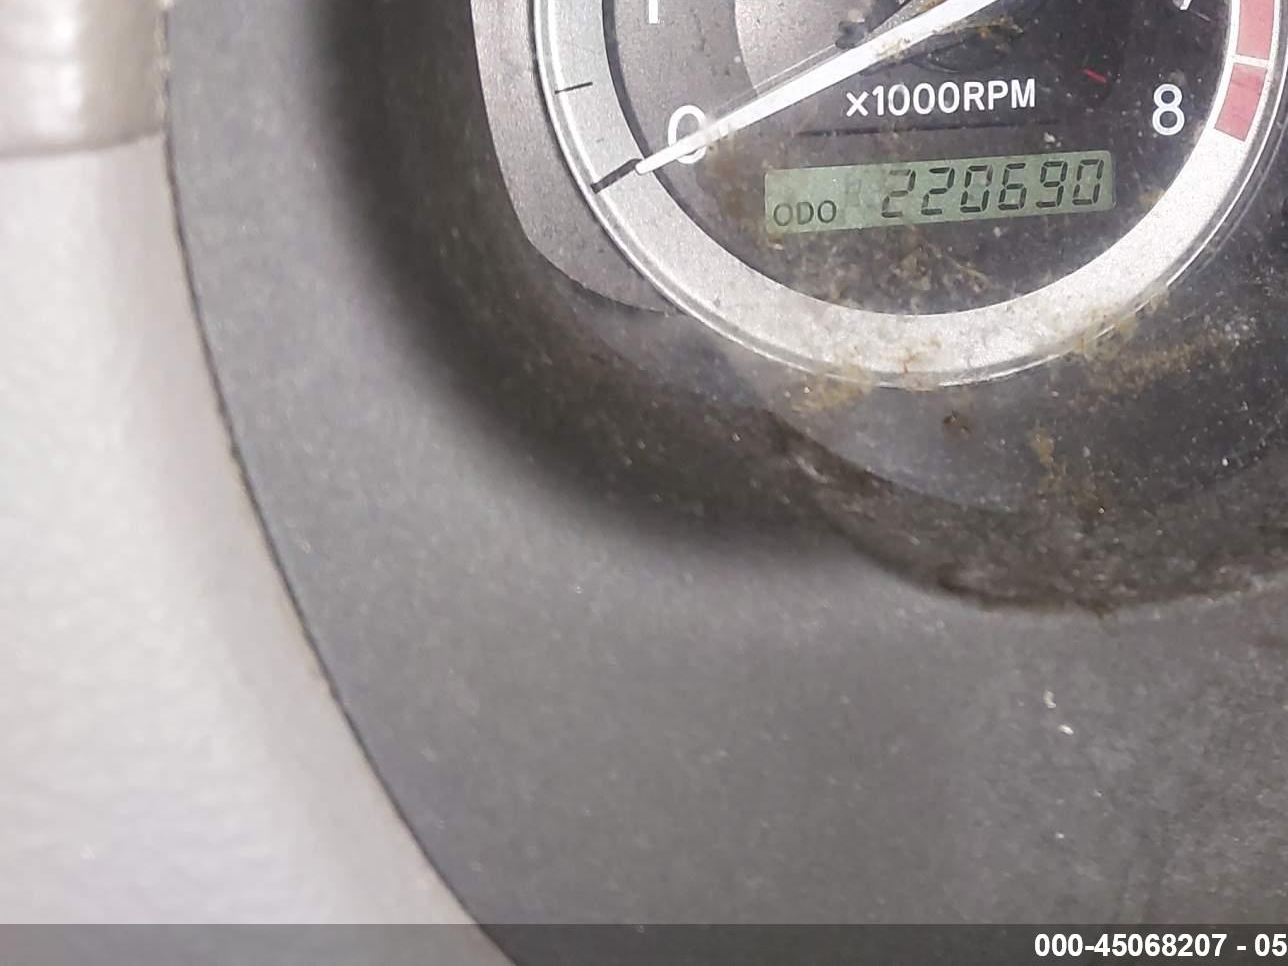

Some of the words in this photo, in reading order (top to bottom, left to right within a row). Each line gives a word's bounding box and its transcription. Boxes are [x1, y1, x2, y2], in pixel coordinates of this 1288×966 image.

[846, 79, 1036, 116] x1000RPM
[1152, 84, 1184, 135] 8
[667, 105, 707, 164] 0
[774, 200, 837, 226] ODO
[881, 159, 1104, 215] 220690
